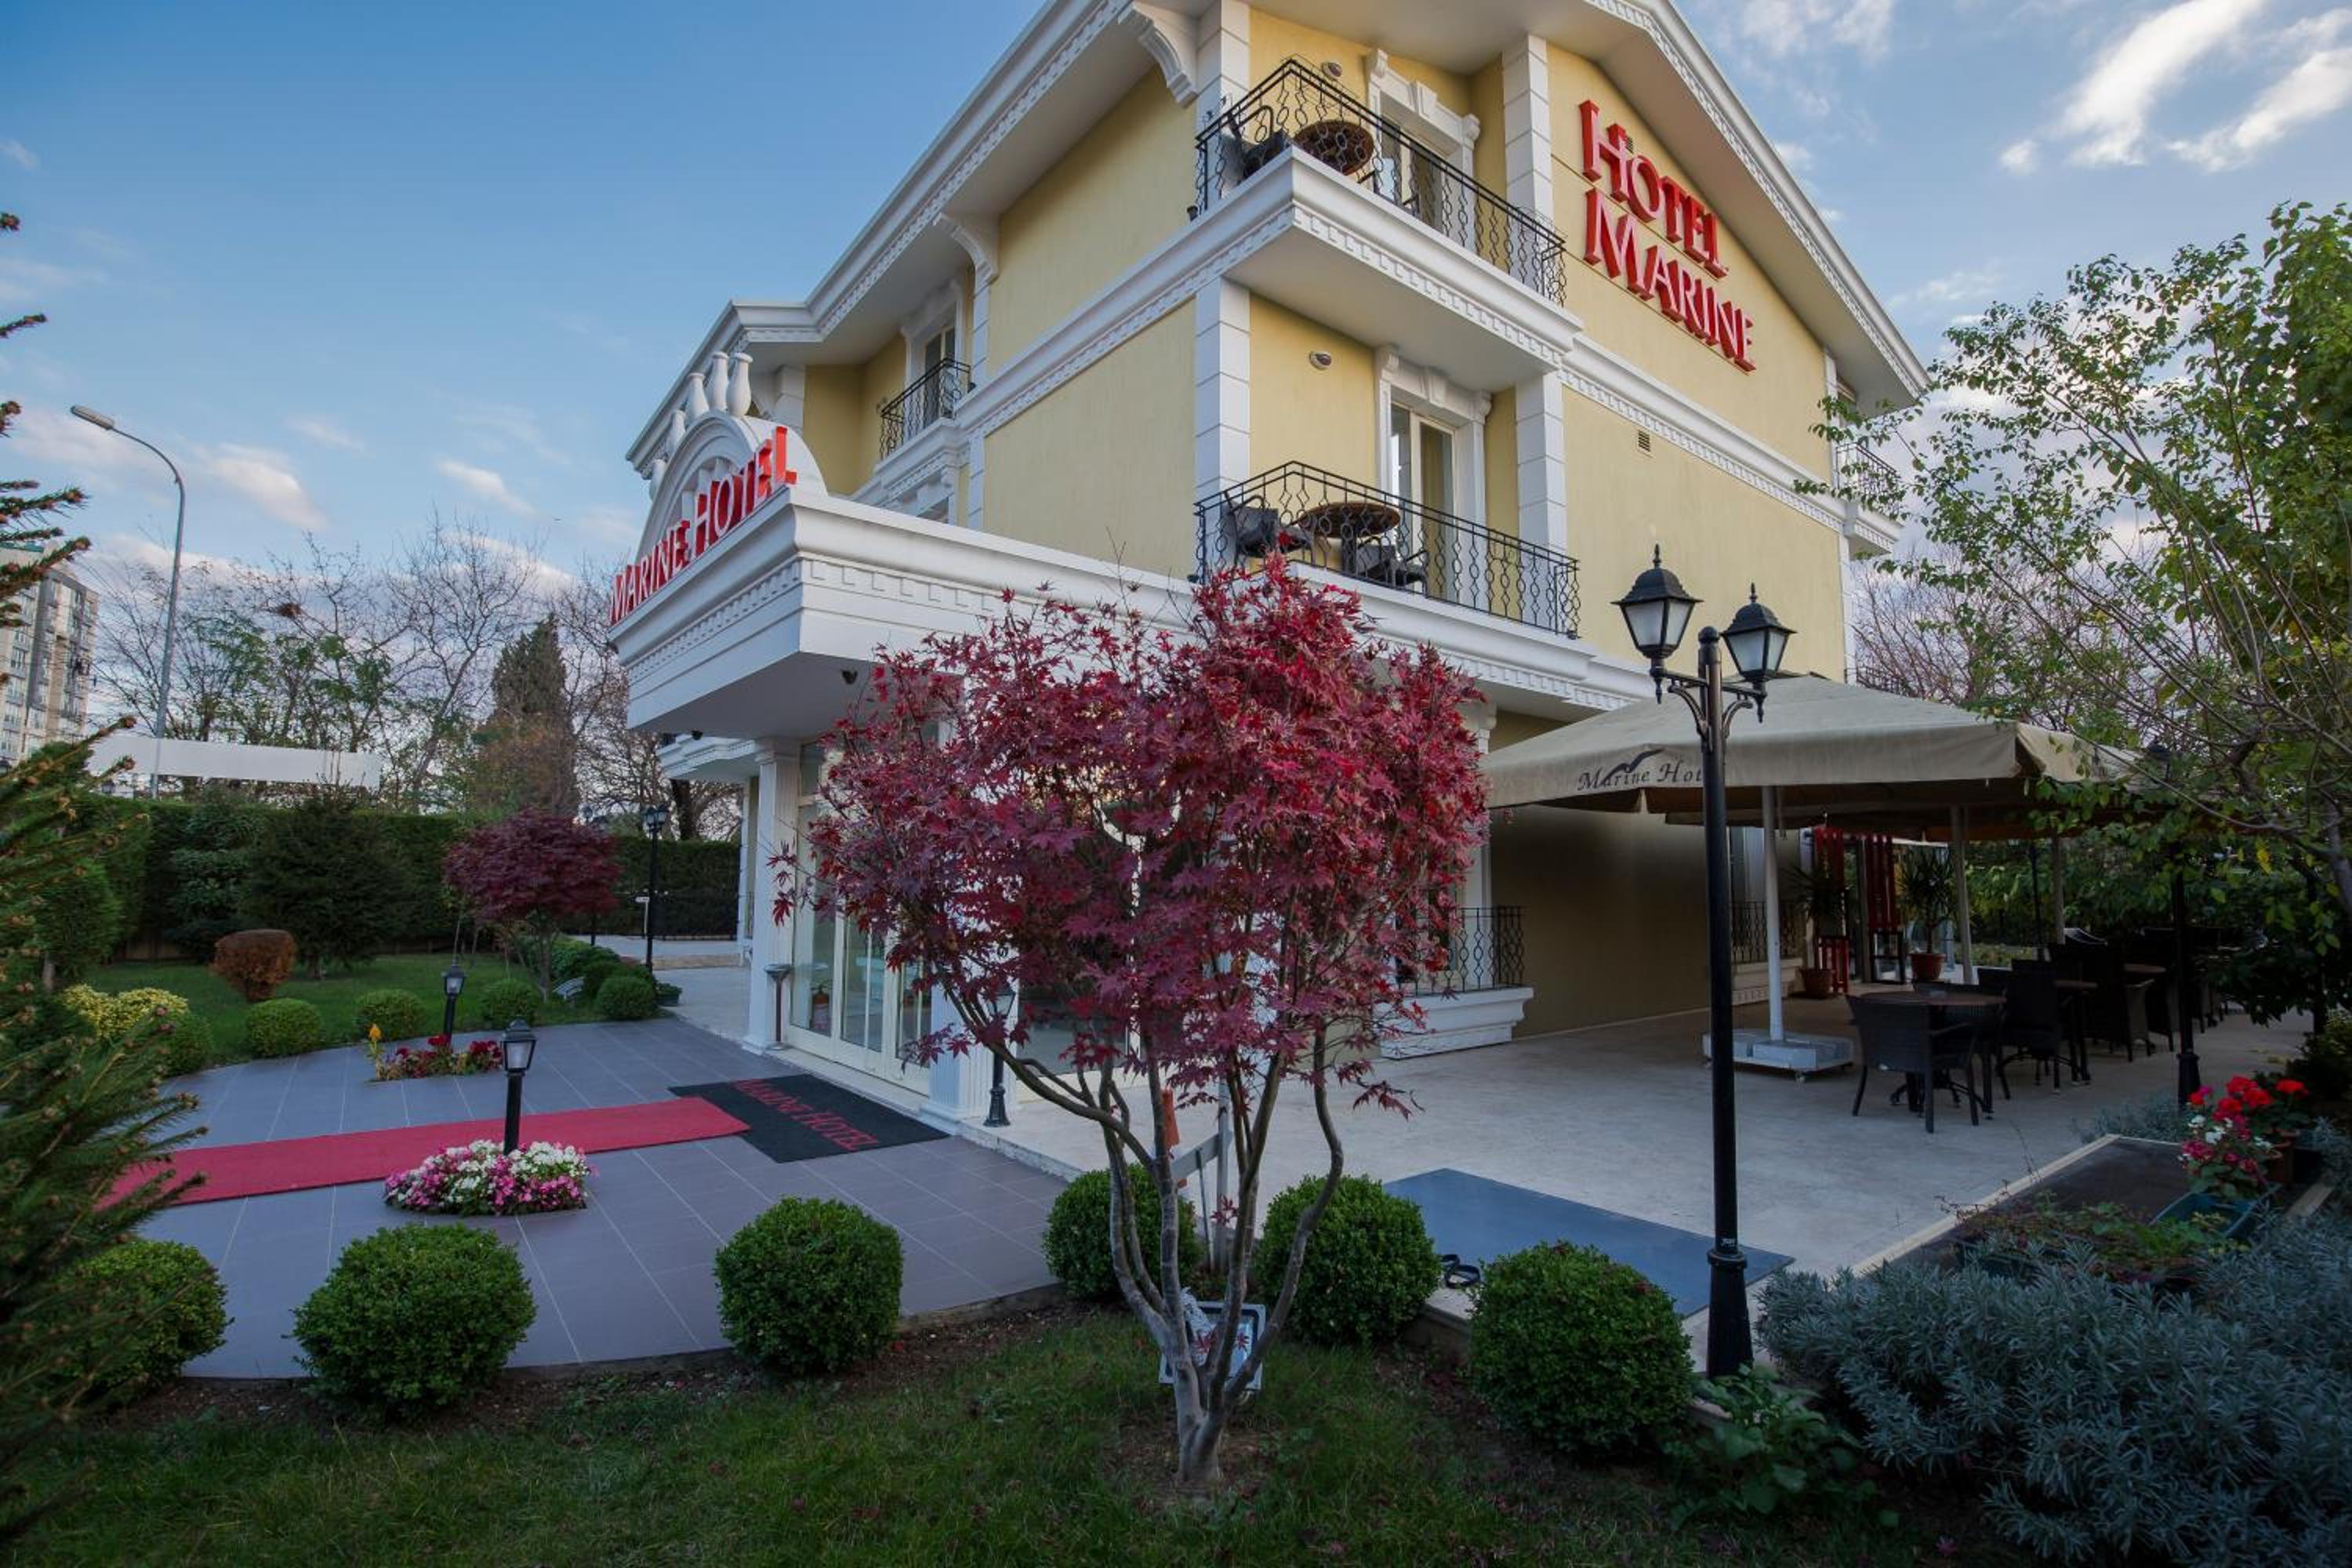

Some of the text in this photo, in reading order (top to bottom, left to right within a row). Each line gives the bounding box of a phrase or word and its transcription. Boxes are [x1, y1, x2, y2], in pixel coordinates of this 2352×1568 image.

[1579, 100, 1729, 279] HOTEL
[1583, 188, 1757, 372] MARINE
[609, 426, 797, 626] MARINE HOTEL
[1577, 758, 1704, 790] Marine Hot
